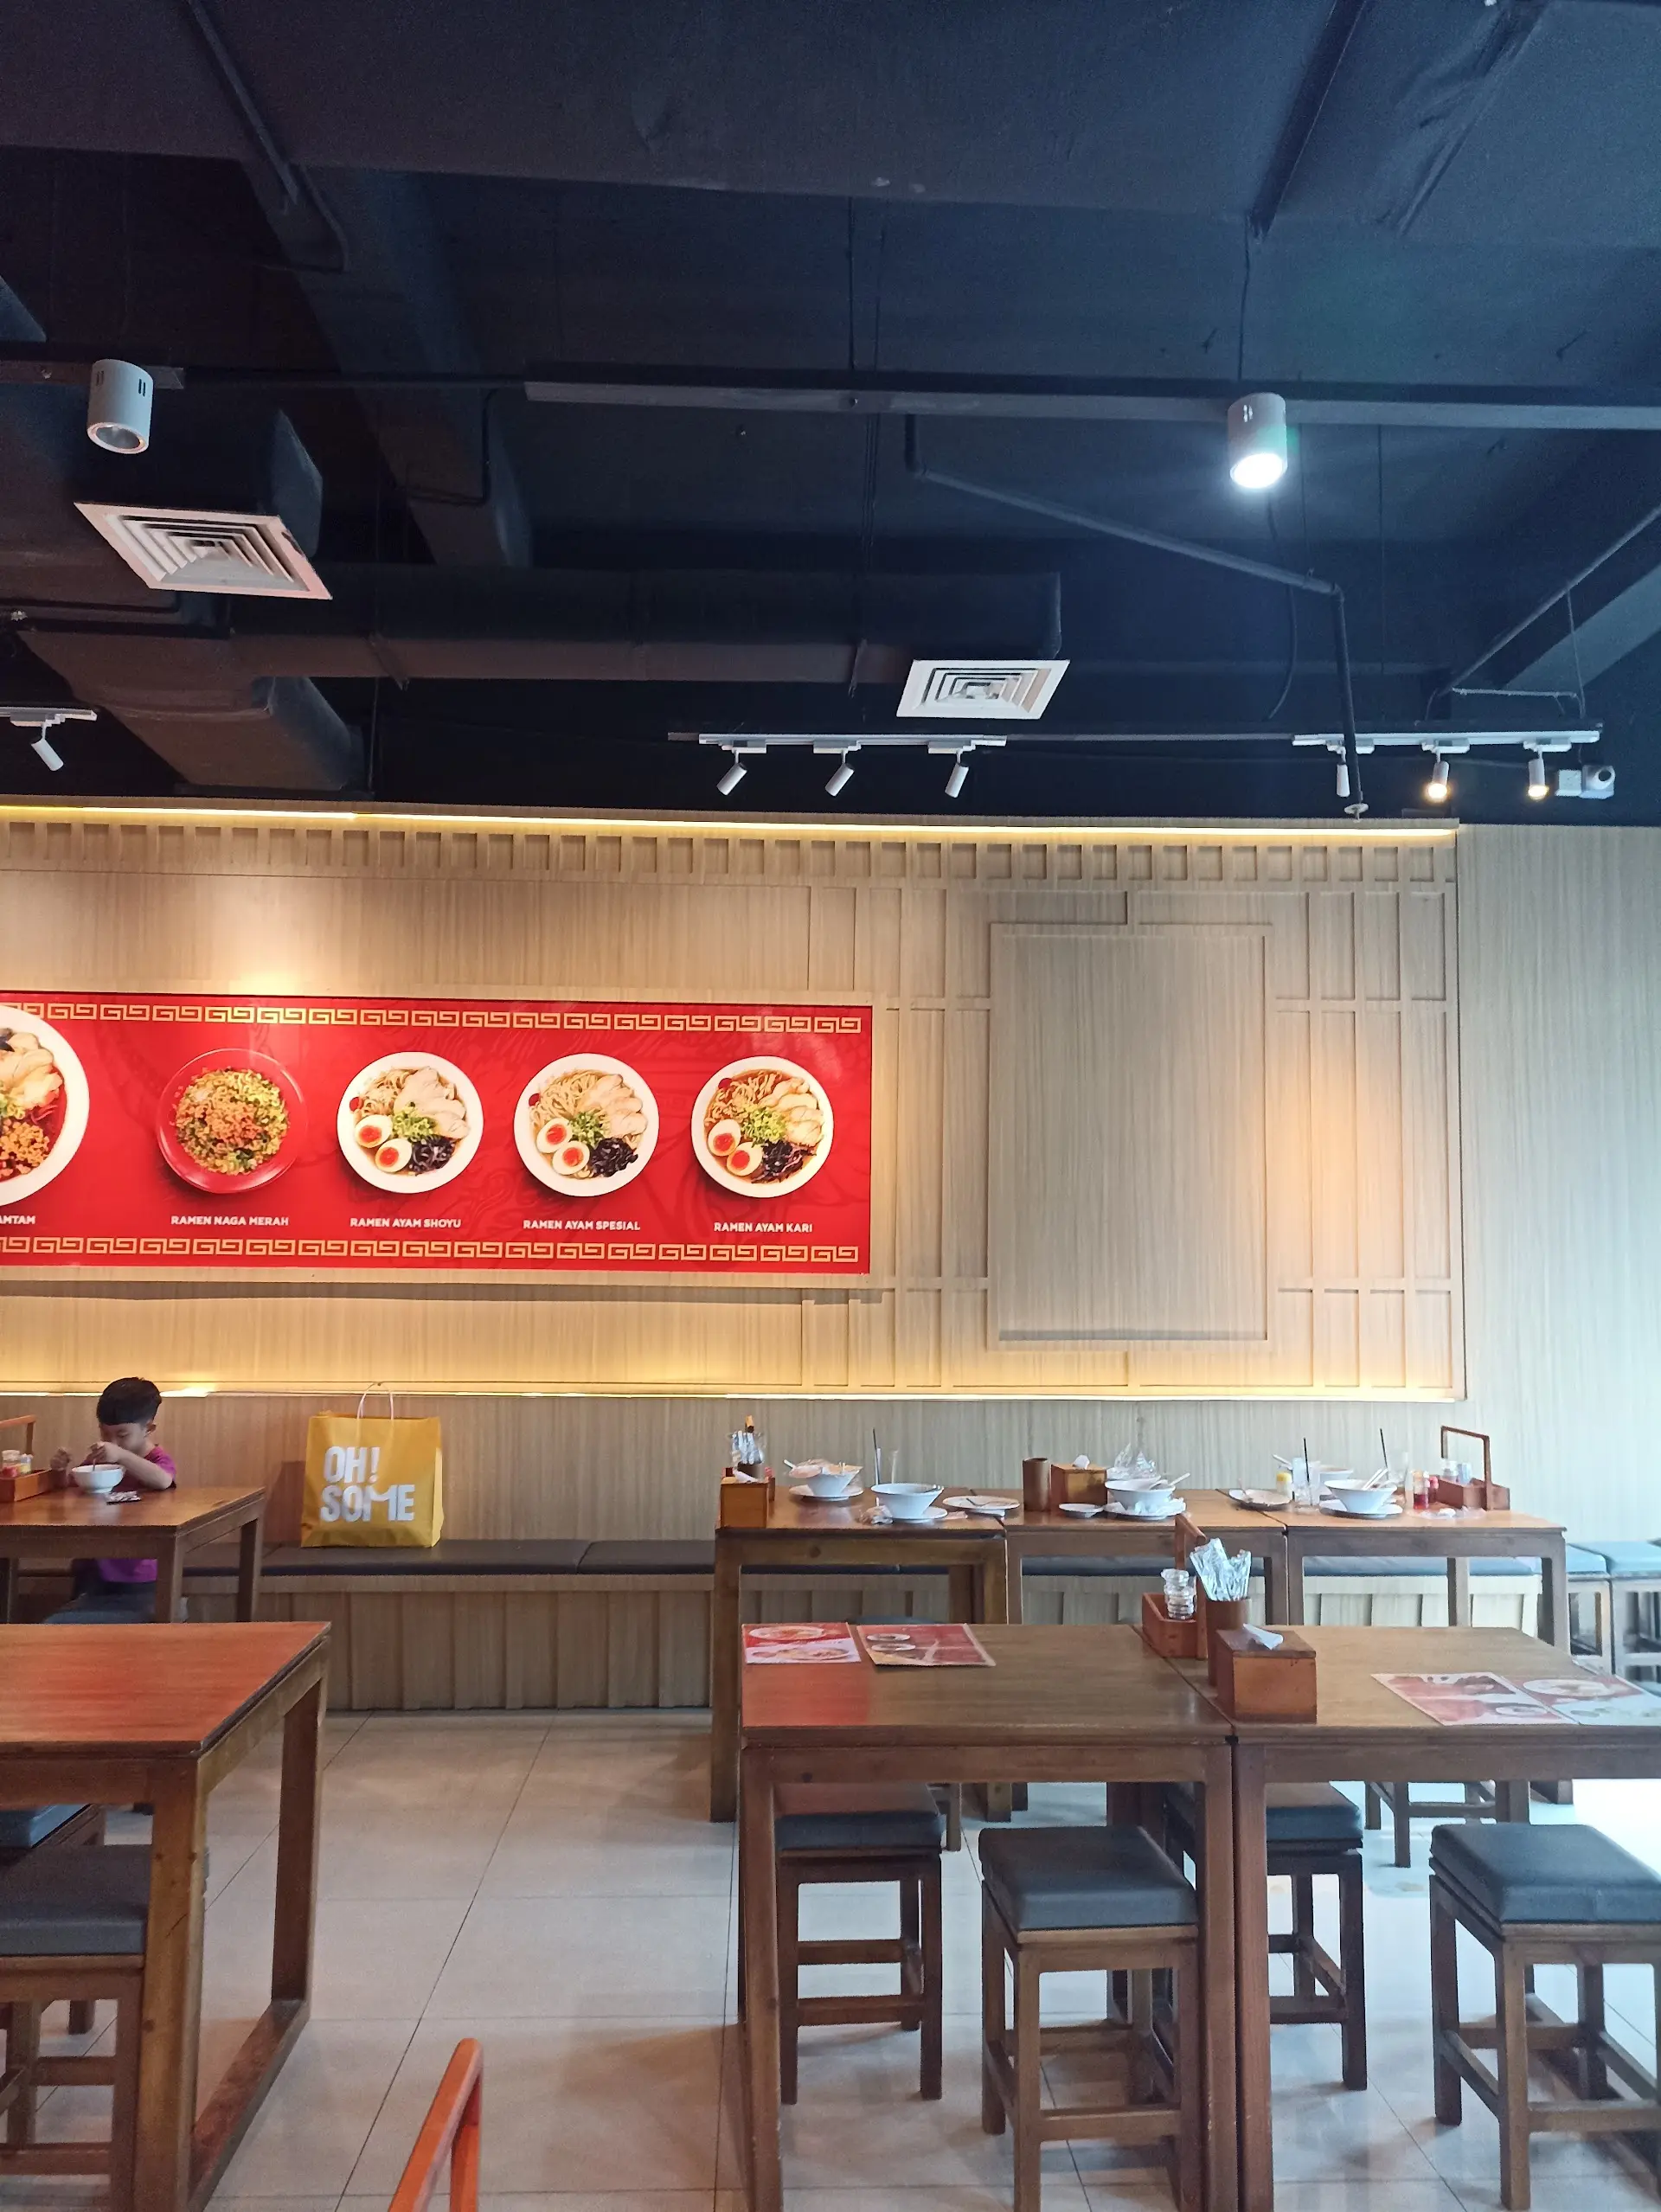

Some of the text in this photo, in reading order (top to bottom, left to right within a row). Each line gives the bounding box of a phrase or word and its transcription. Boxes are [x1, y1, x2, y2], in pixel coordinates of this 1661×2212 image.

[170, 1215, 290, 1227] RAMEN NAGA MERAH
[350, 1216, 462, 1229] RAMEN AYAM SHOYU
[523, 1219, 641, 1231] RAMEN AYAM SPESIAL
[714, 1221, 813, 1233] RAMEN AYAM KARI
[323, 1446, 381, 1484] OH!
[319, 1484, 415, 1523] SOME
